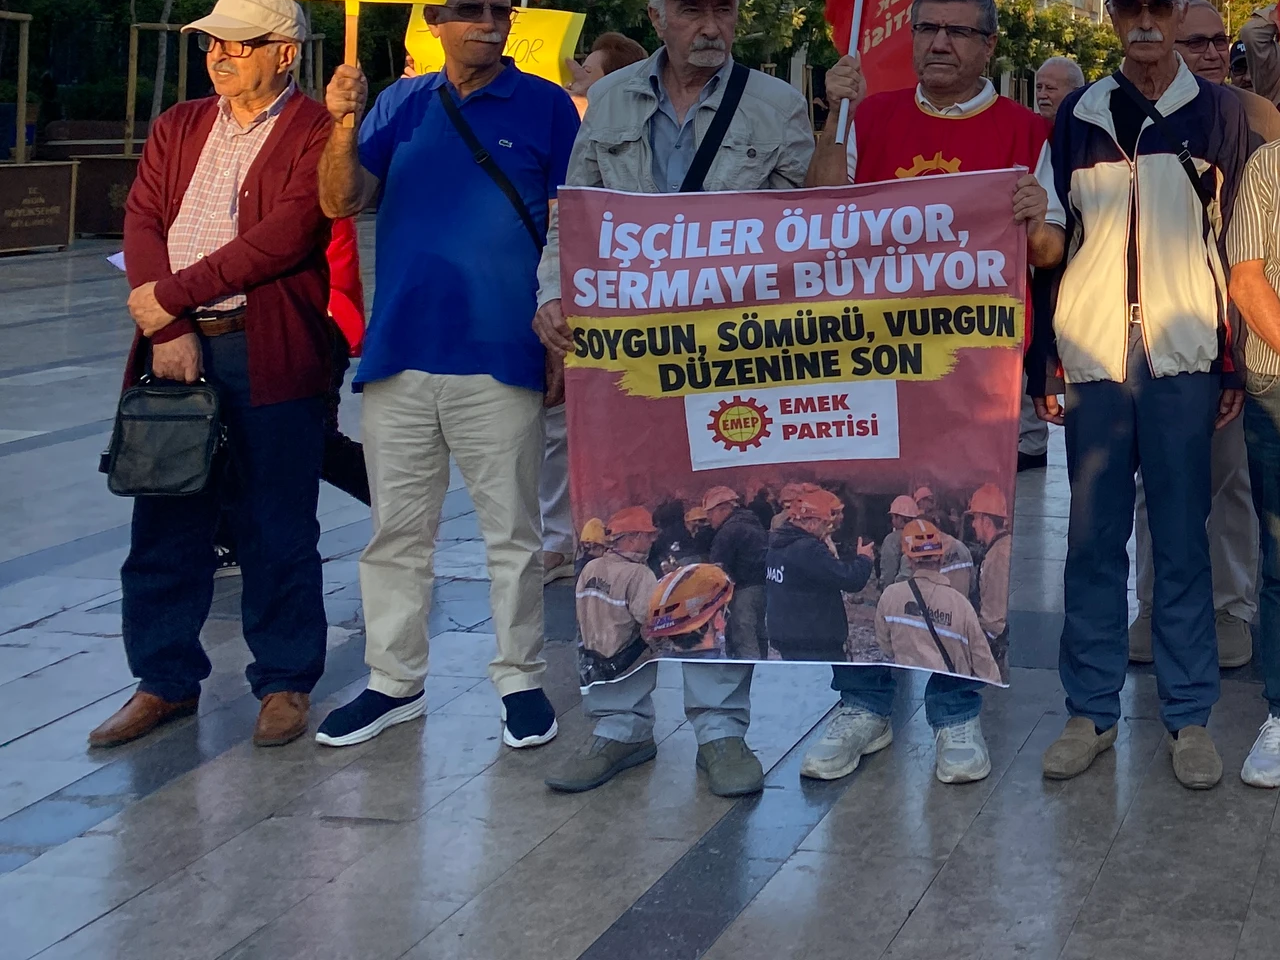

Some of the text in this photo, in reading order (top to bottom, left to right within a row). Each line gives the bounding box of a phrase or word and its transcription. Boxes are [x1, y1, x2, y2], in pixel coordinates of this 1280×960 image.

[598, 203, 969, 269] İŞÇİLER ÖLÜYOR,
[572, 246, 1008, 310] SERMAYE BÜYÜYOR
[572, 305, 1015, 361] SOYGUN, SÖMÜRÜ, VURGUN
[658, 343, 922, 392] DÜZENİNE SON
[722, 417, 759, 431] EMEP
[779, 393, 850, 416] EMEK
[782, 412, 879, 441] PARTİSİ
